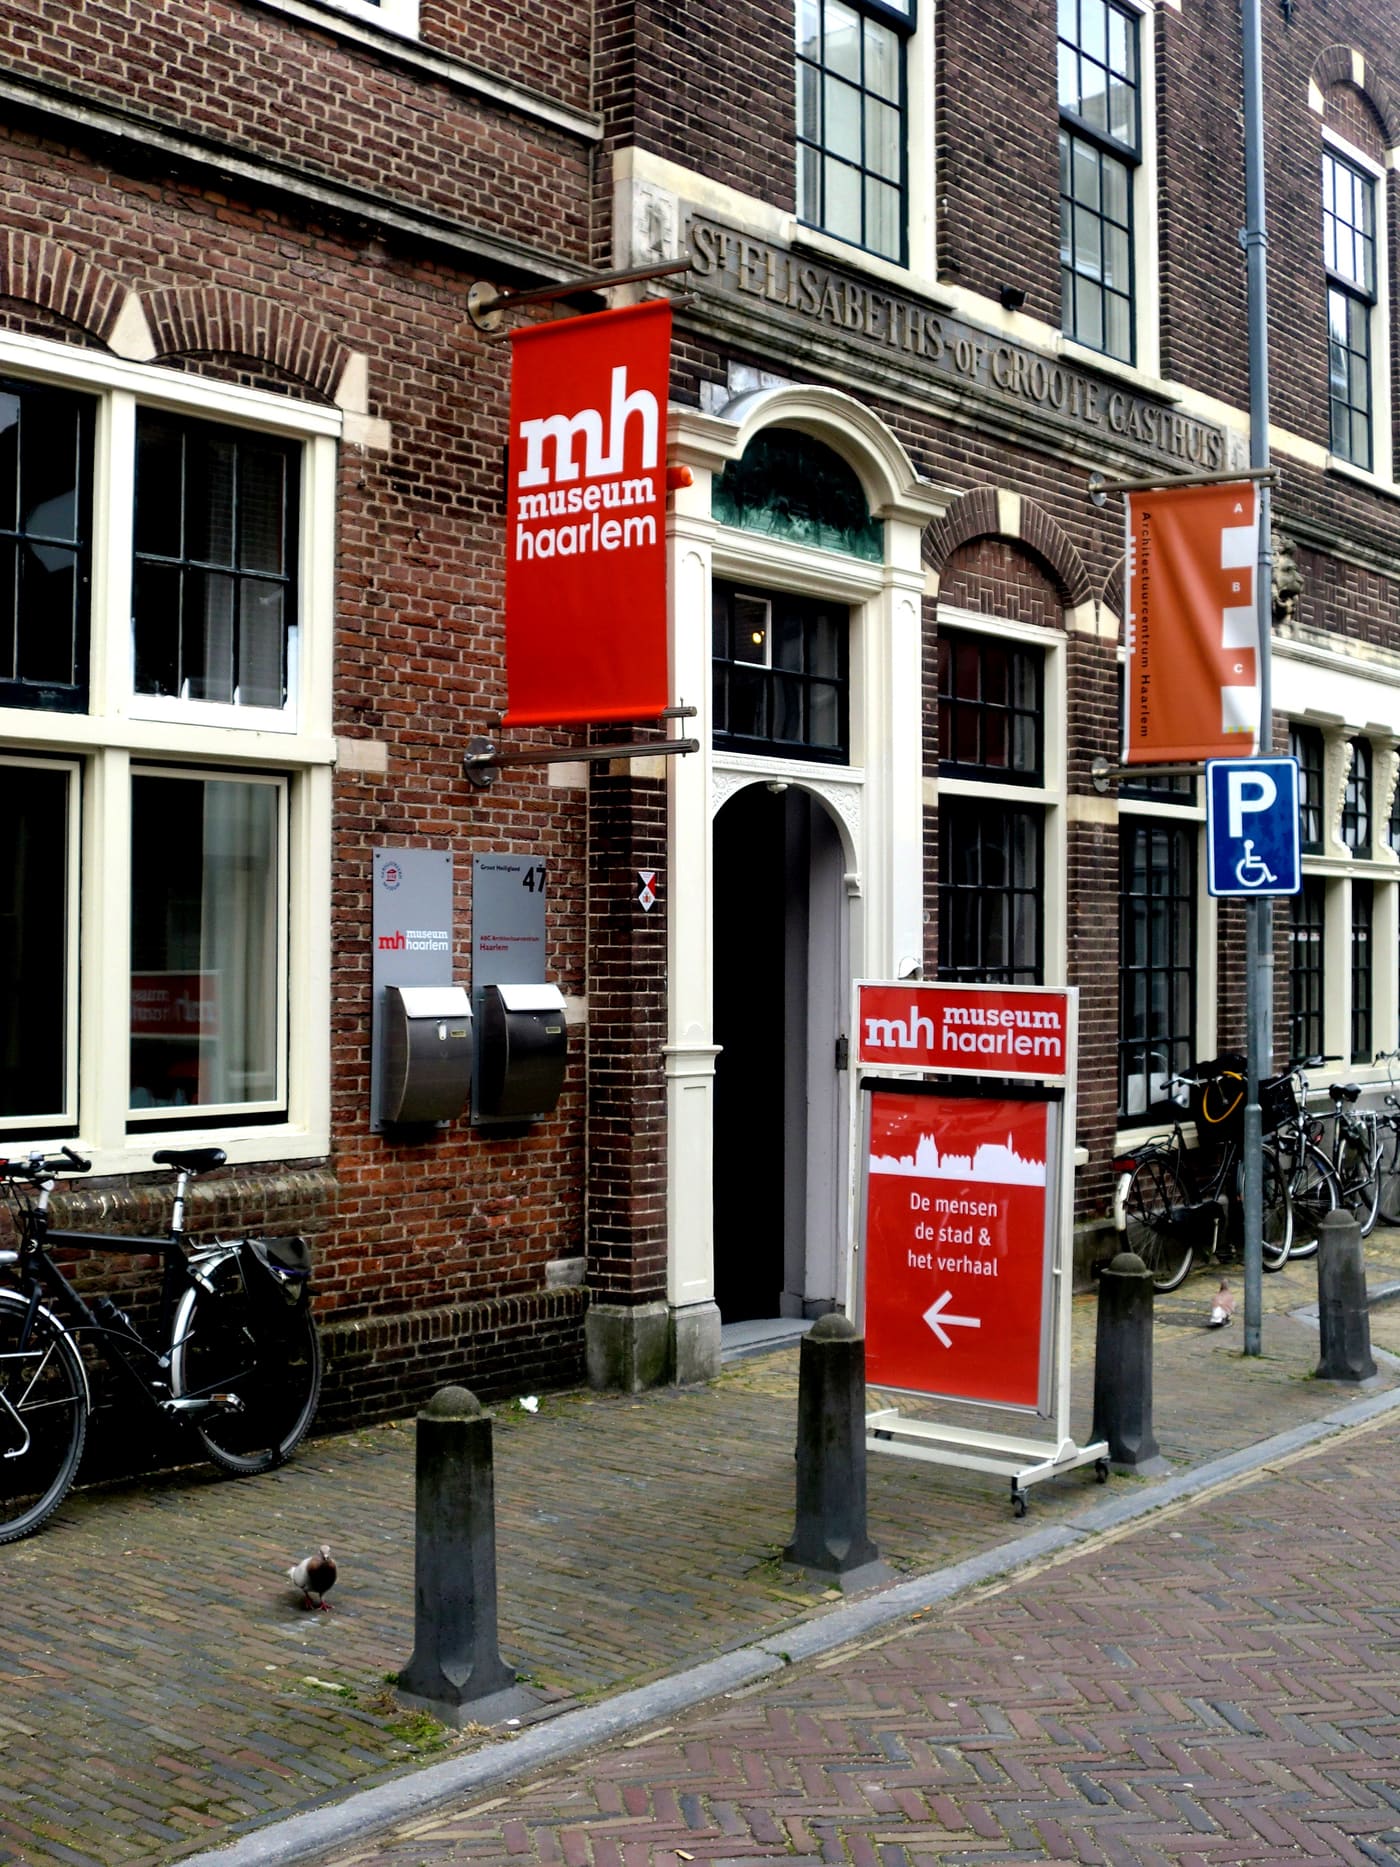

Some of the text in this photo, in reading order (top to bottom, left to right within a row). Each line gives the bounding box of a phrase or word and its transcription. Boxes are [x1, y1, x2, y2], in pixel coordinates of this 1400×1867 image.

[955, 339, 982, 377] OF
[991, 348, 1101, 424] GROOTE
[1109, 392, 1221, 471] GASTHUIS
[519, 365, 659, 488] mh
[517, 476, 656, 520] museum
[1233, 503, 1243, 513] A
[516, 512, 656, 561] haarlem
[1232, 582, 1241, 593] B
[1140, 511, 1151, 738] Architectuurcentrum Haarlem
[1233, 663, 1243, 674] C
[1228, 771, 1277, 838] P
[522, 866, 546, 893] 47
[378, 929, 405, 950] mh
[406, 930, 448, 939] museum
[406, 938, 448, 951] haarlem
[480, 943, 509, 951] Haarlem
[865, 1006, 934, 1050] mh
[942, 1007, 1061, 1030] museum
[942, 1025, 1061, 1057] haarlem
[911, 1192, 998, 1217] De mensen
[915, 1222, 991, 1246] de stad &
[908, 1250, 998, 1277] het verhaal
